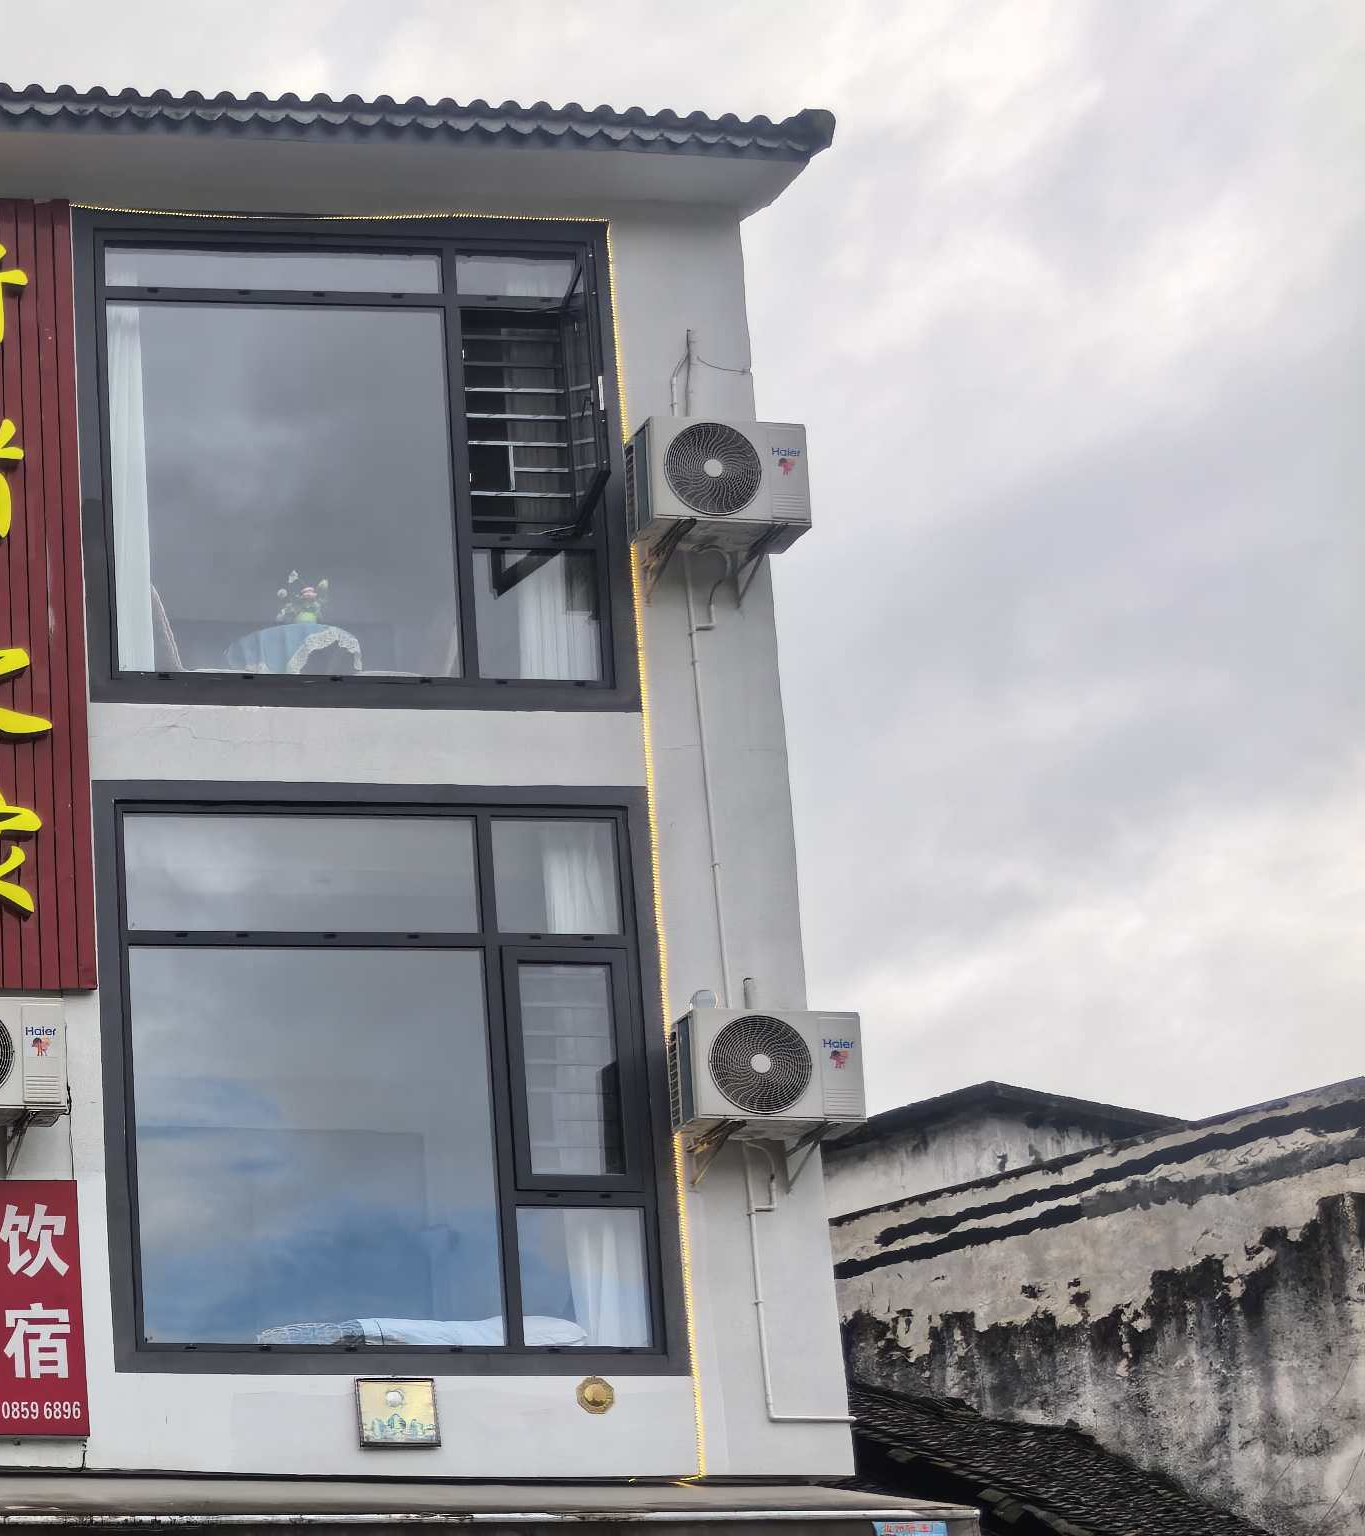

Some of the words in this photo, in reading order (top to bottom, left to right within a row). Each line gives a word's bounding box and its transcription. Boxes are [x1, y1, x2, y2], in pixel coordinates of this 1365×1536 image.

[25, 1025, 57, 1036] Haier
[822, 1038, 854, 1049] Haier
[1, 1401, 40, 1420] 0859
[43, 1401, 82, 1420] 6896
